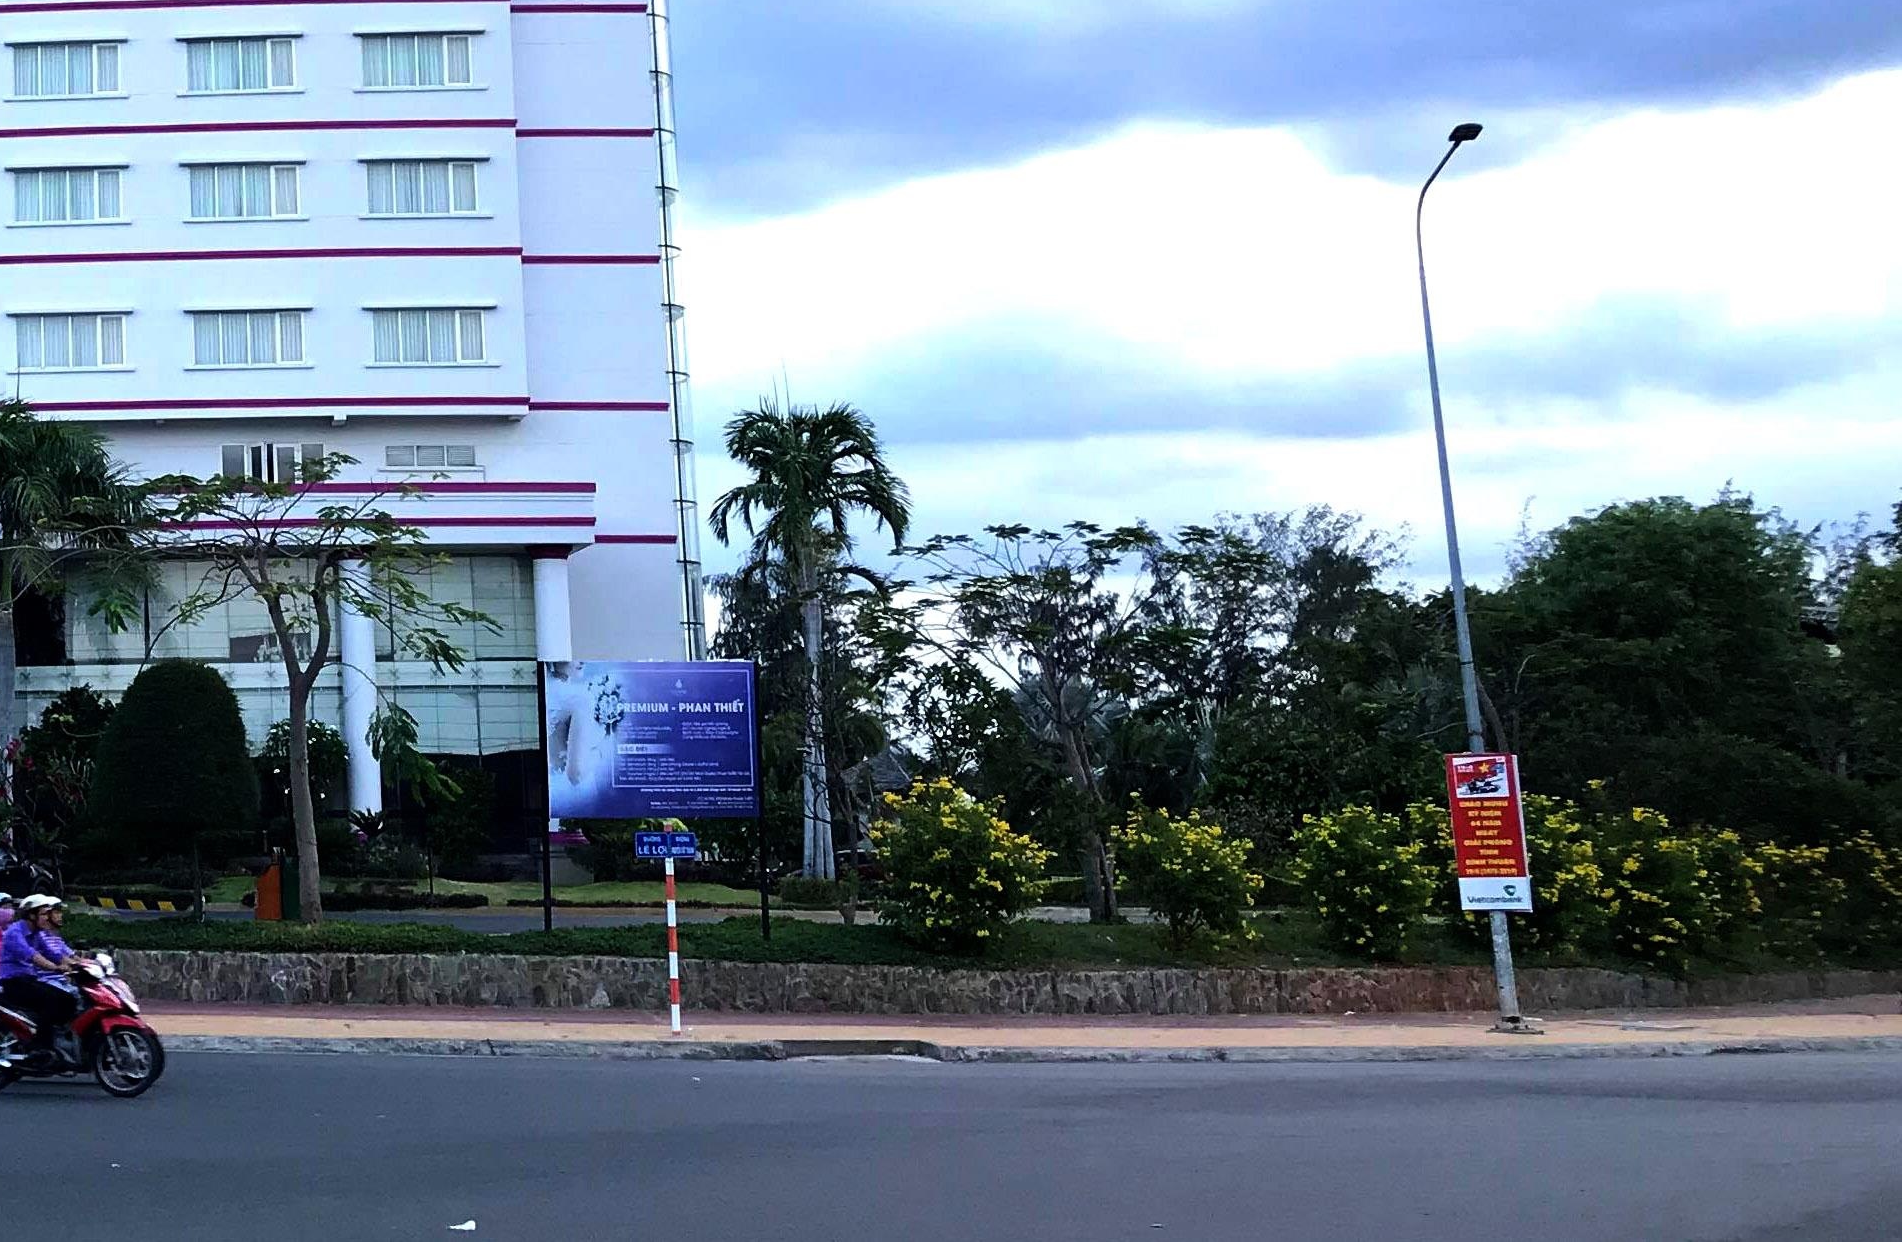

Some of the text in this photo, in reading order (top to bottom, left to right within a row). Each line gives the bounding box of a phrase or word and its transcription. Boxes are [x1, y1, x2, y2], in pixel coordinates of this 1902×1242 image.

[617, 702, 669, 713] PREMIUM
[679, 702, 711, 713] PHAN
[714, 698, 745, 713] THIẾT
